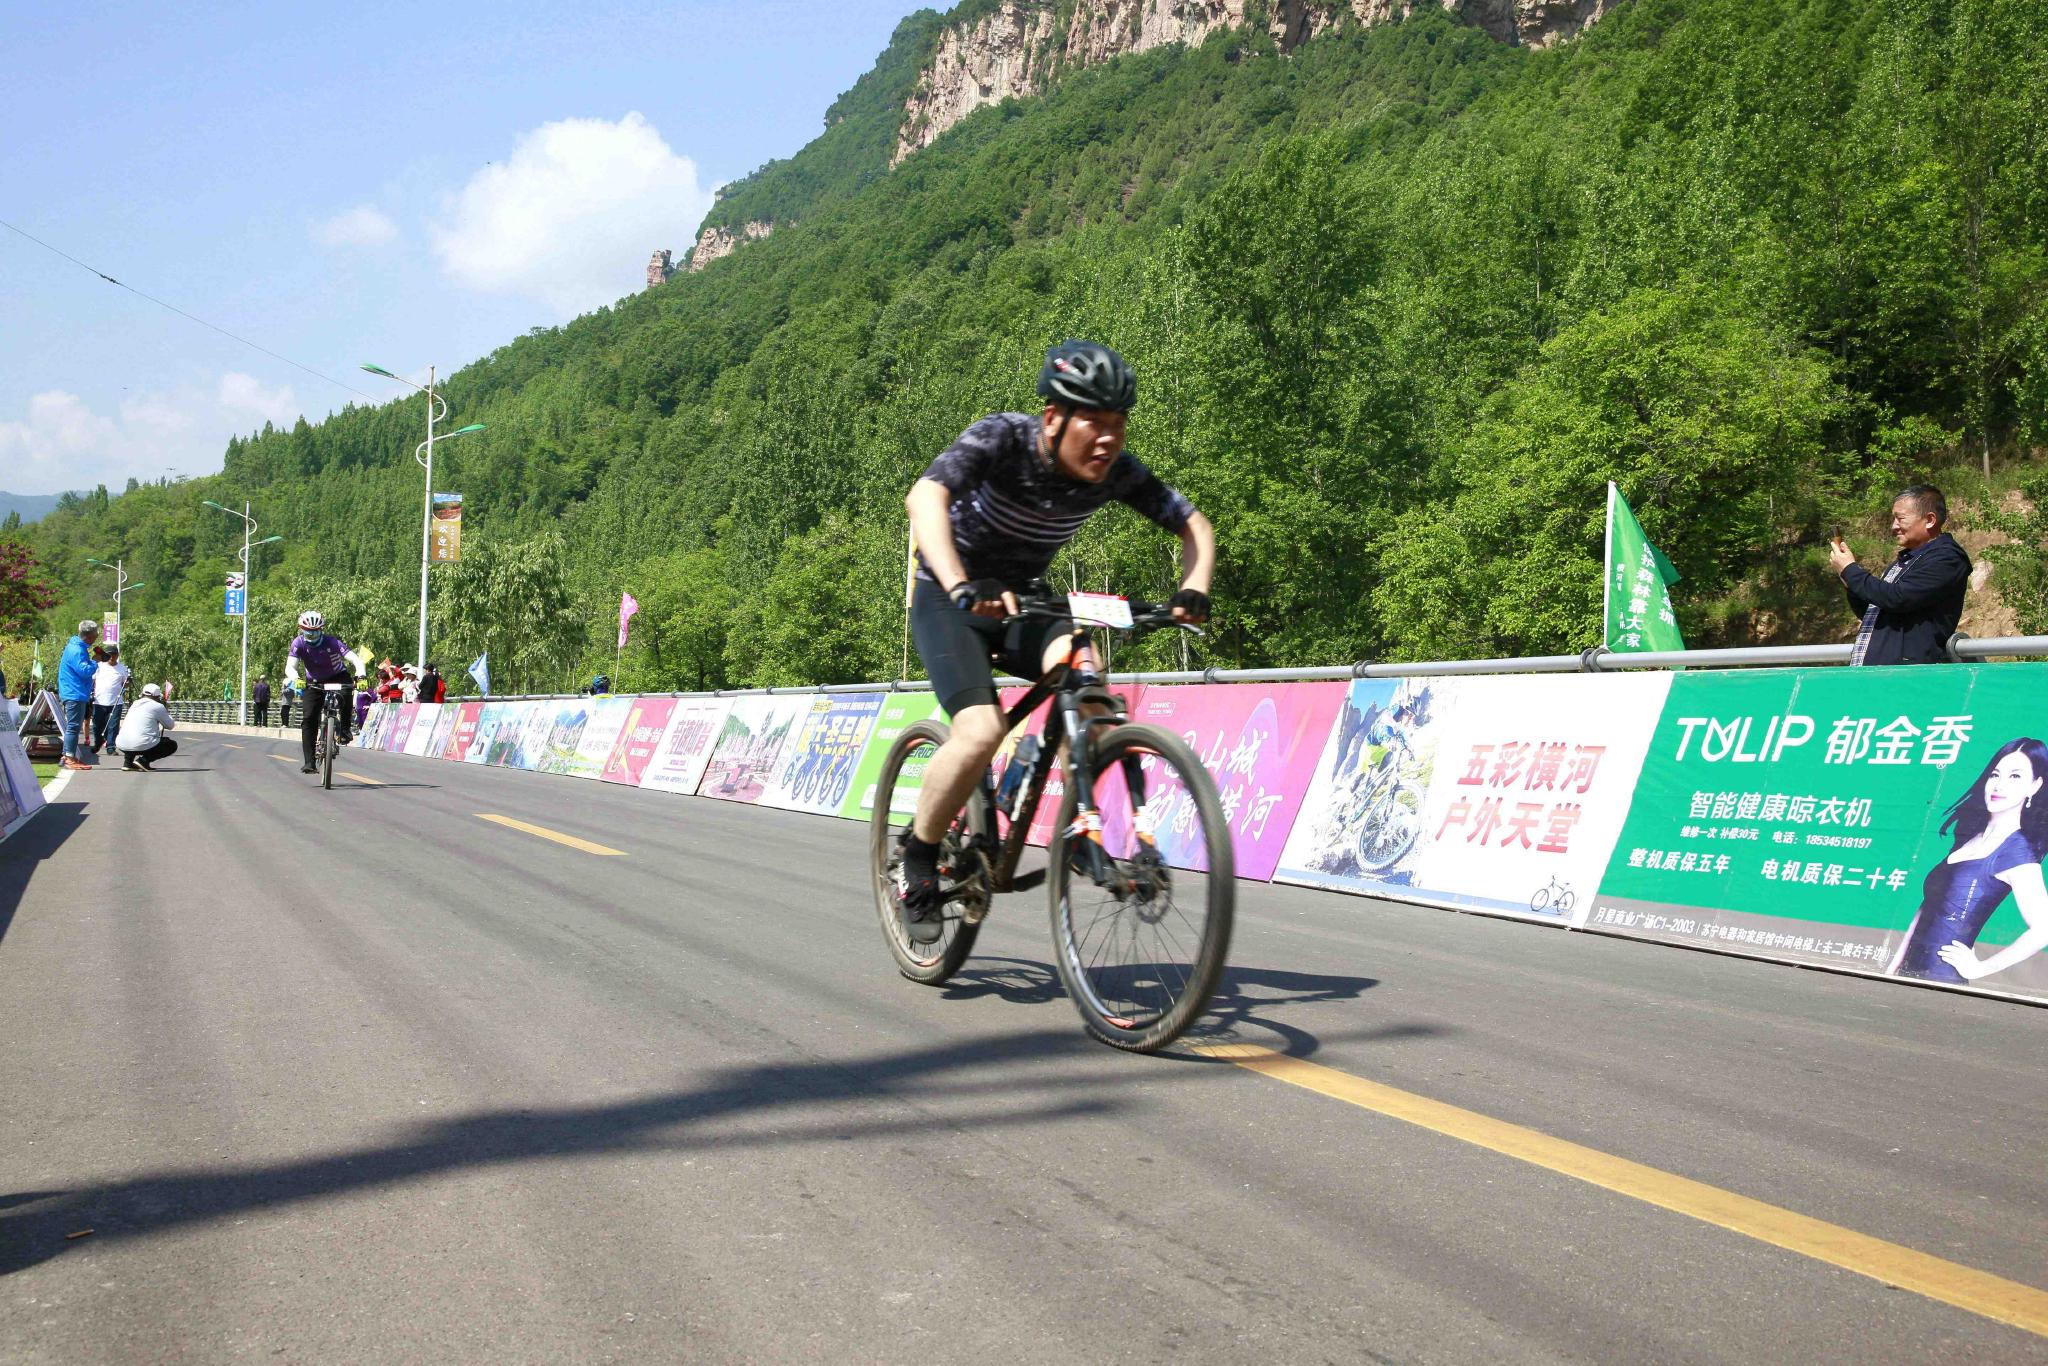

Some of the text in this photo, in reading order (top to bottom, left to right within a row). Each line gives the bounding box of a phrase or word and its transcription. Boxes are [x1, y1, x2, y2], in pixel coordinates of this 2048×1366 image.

[1824, 714, 1974, 765] 郁金香
[1457, 741, 1607, 794] 五彩横河
[1435, 796, 1581, 853] 户外天堂
[1688, 790, 1873, 827] 智能健康晾衣机
[1679, 825, 1718, 838] 维修一次
[1719, 827, 1760, 841] 补偿30元
[1805, 834, 1873, 849] 18534518197
[1627, 847, 1732, 875] 整机质保五年
[1760, 858, 1908, 892] 电机质保二十年
